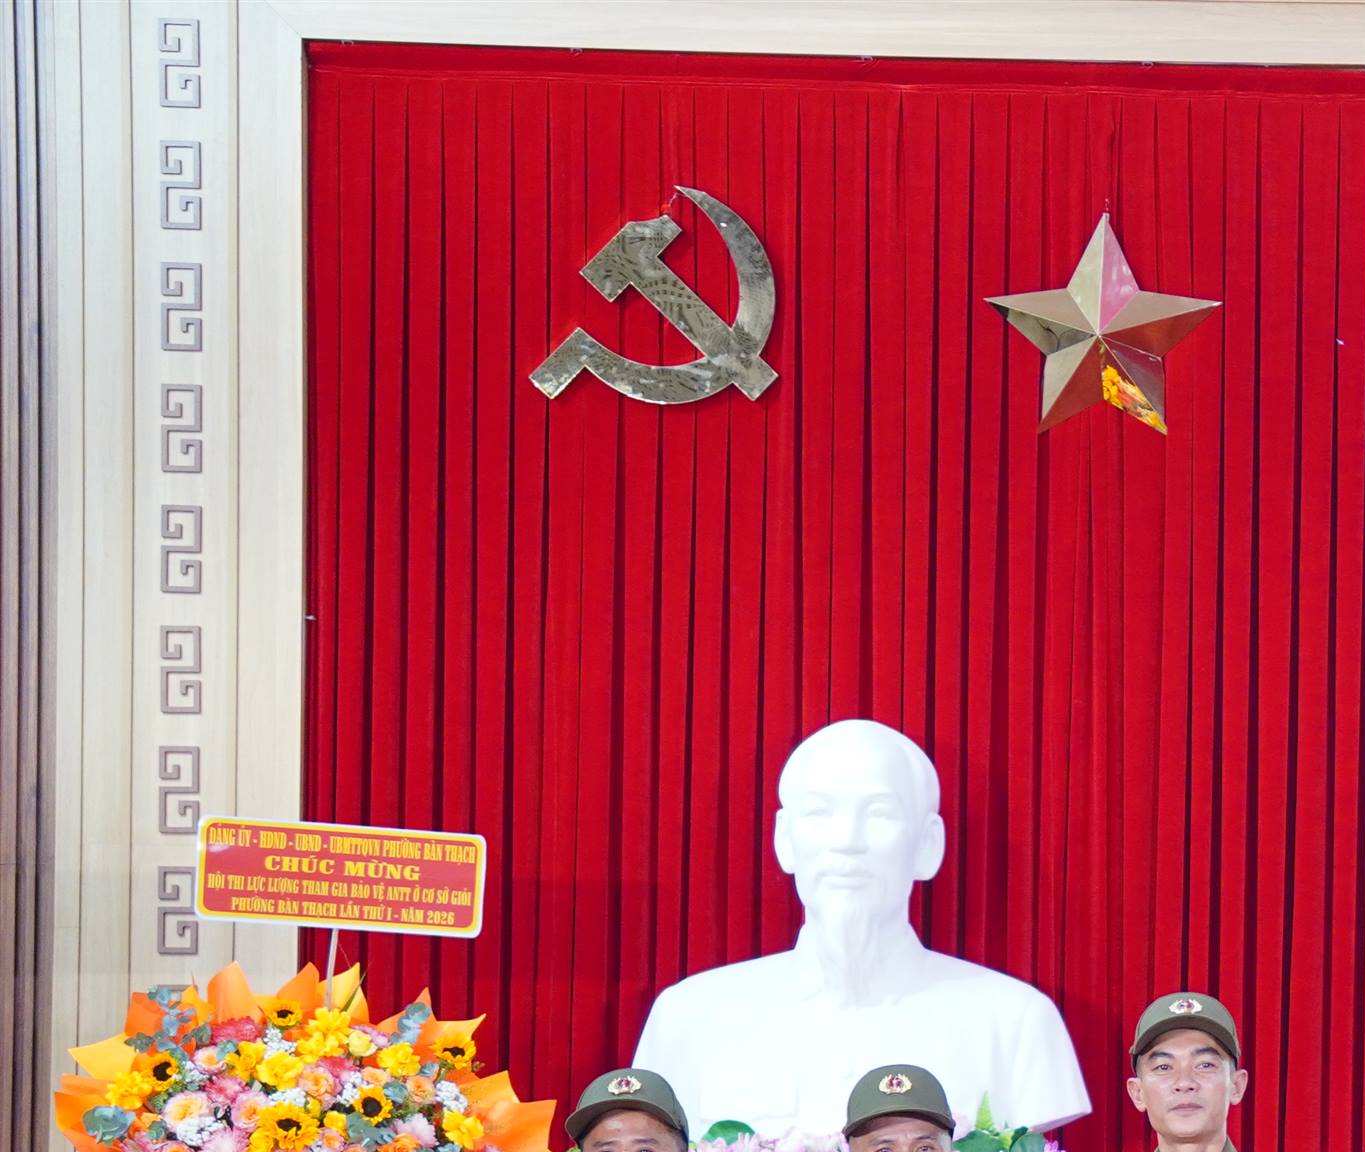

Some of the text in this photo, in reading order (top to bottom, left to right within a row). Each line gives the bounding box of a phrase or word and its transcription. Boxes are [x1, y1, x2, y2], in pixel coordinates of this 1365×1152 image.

[208, 823, 236, 846] ĐẢNG
[295, 833, 321, 852] UBND
[383, 838, 421, 859] PHƯỜNG
[423, 840, 442, 861] BÀN
[445, 845, 476, 866] THẠCH
[264, 855, 421, 881] CHÚC MỪNG
[207, 871, 225, 890] HỘI
[227, 874, 244, 890] THI
[302, 880, 329, 896] THAM
[332, 882, 348, 898] GIA
[386, 886, 411, 902] ANTT
[302, 902, 337, 918] THẠCH
[387, 907, 392, 921] I
[426, 910, 455, 925] 2026
